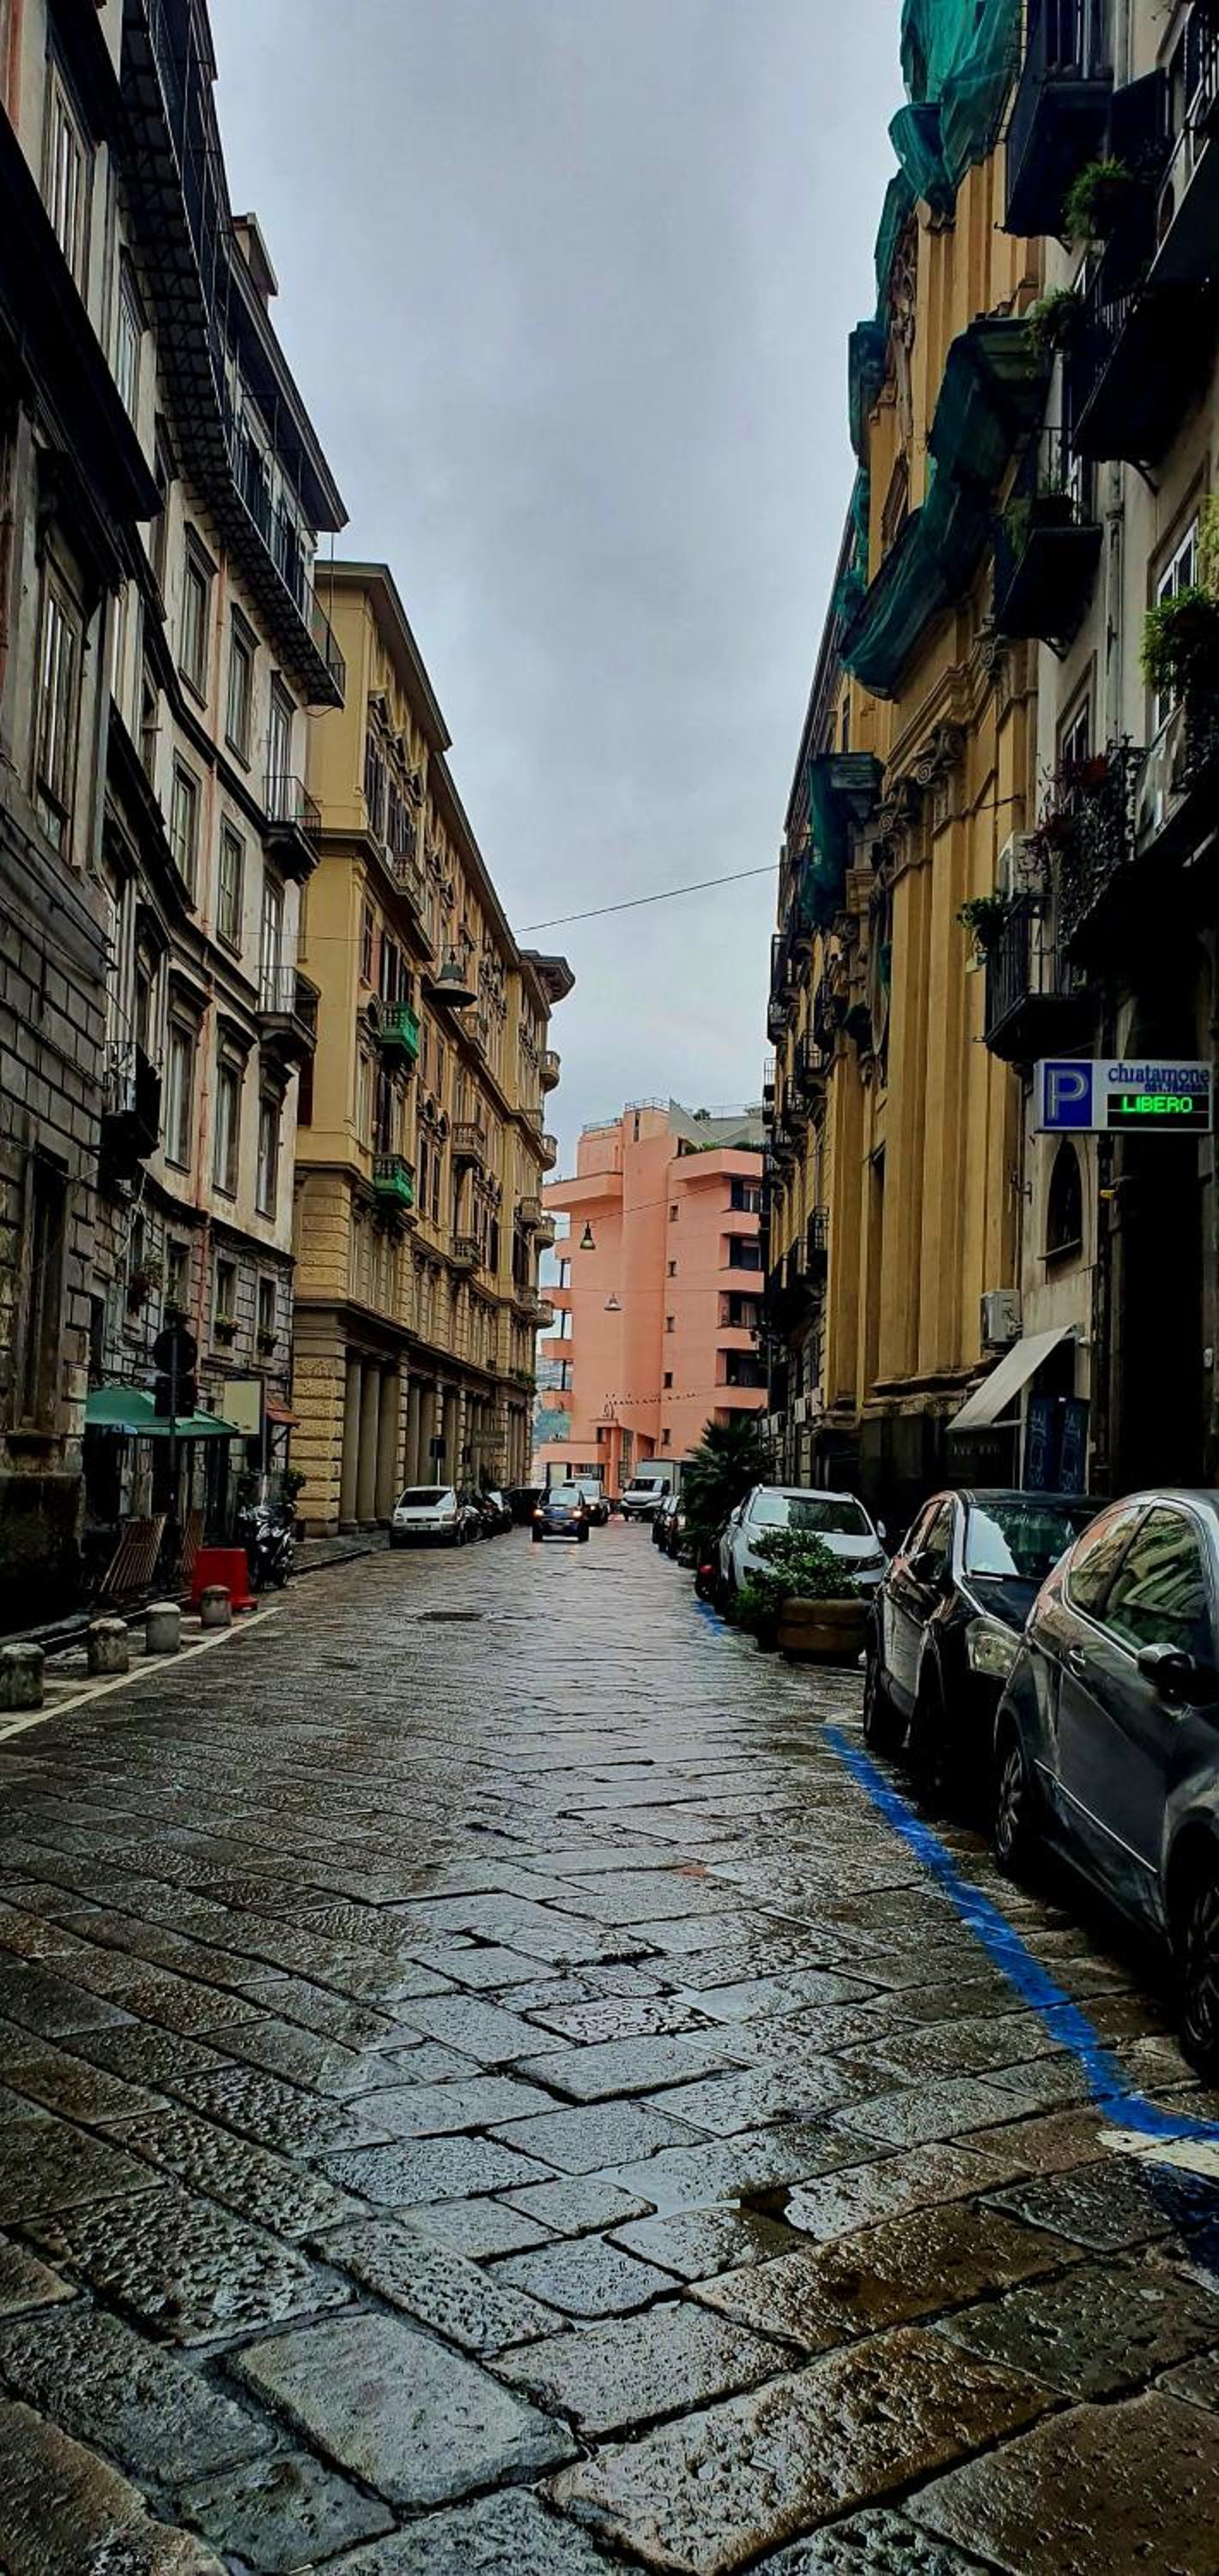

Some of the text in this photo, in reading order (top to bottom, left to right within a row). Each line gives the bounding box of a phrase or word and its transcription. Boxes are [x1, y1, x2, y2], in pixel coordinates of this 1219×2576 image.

[1107, 1063, 1210, 1084] chiatamone
[1046, 1071, 1089, 1120] P
[1122, 1096, 1192, 1113] LIBERO
